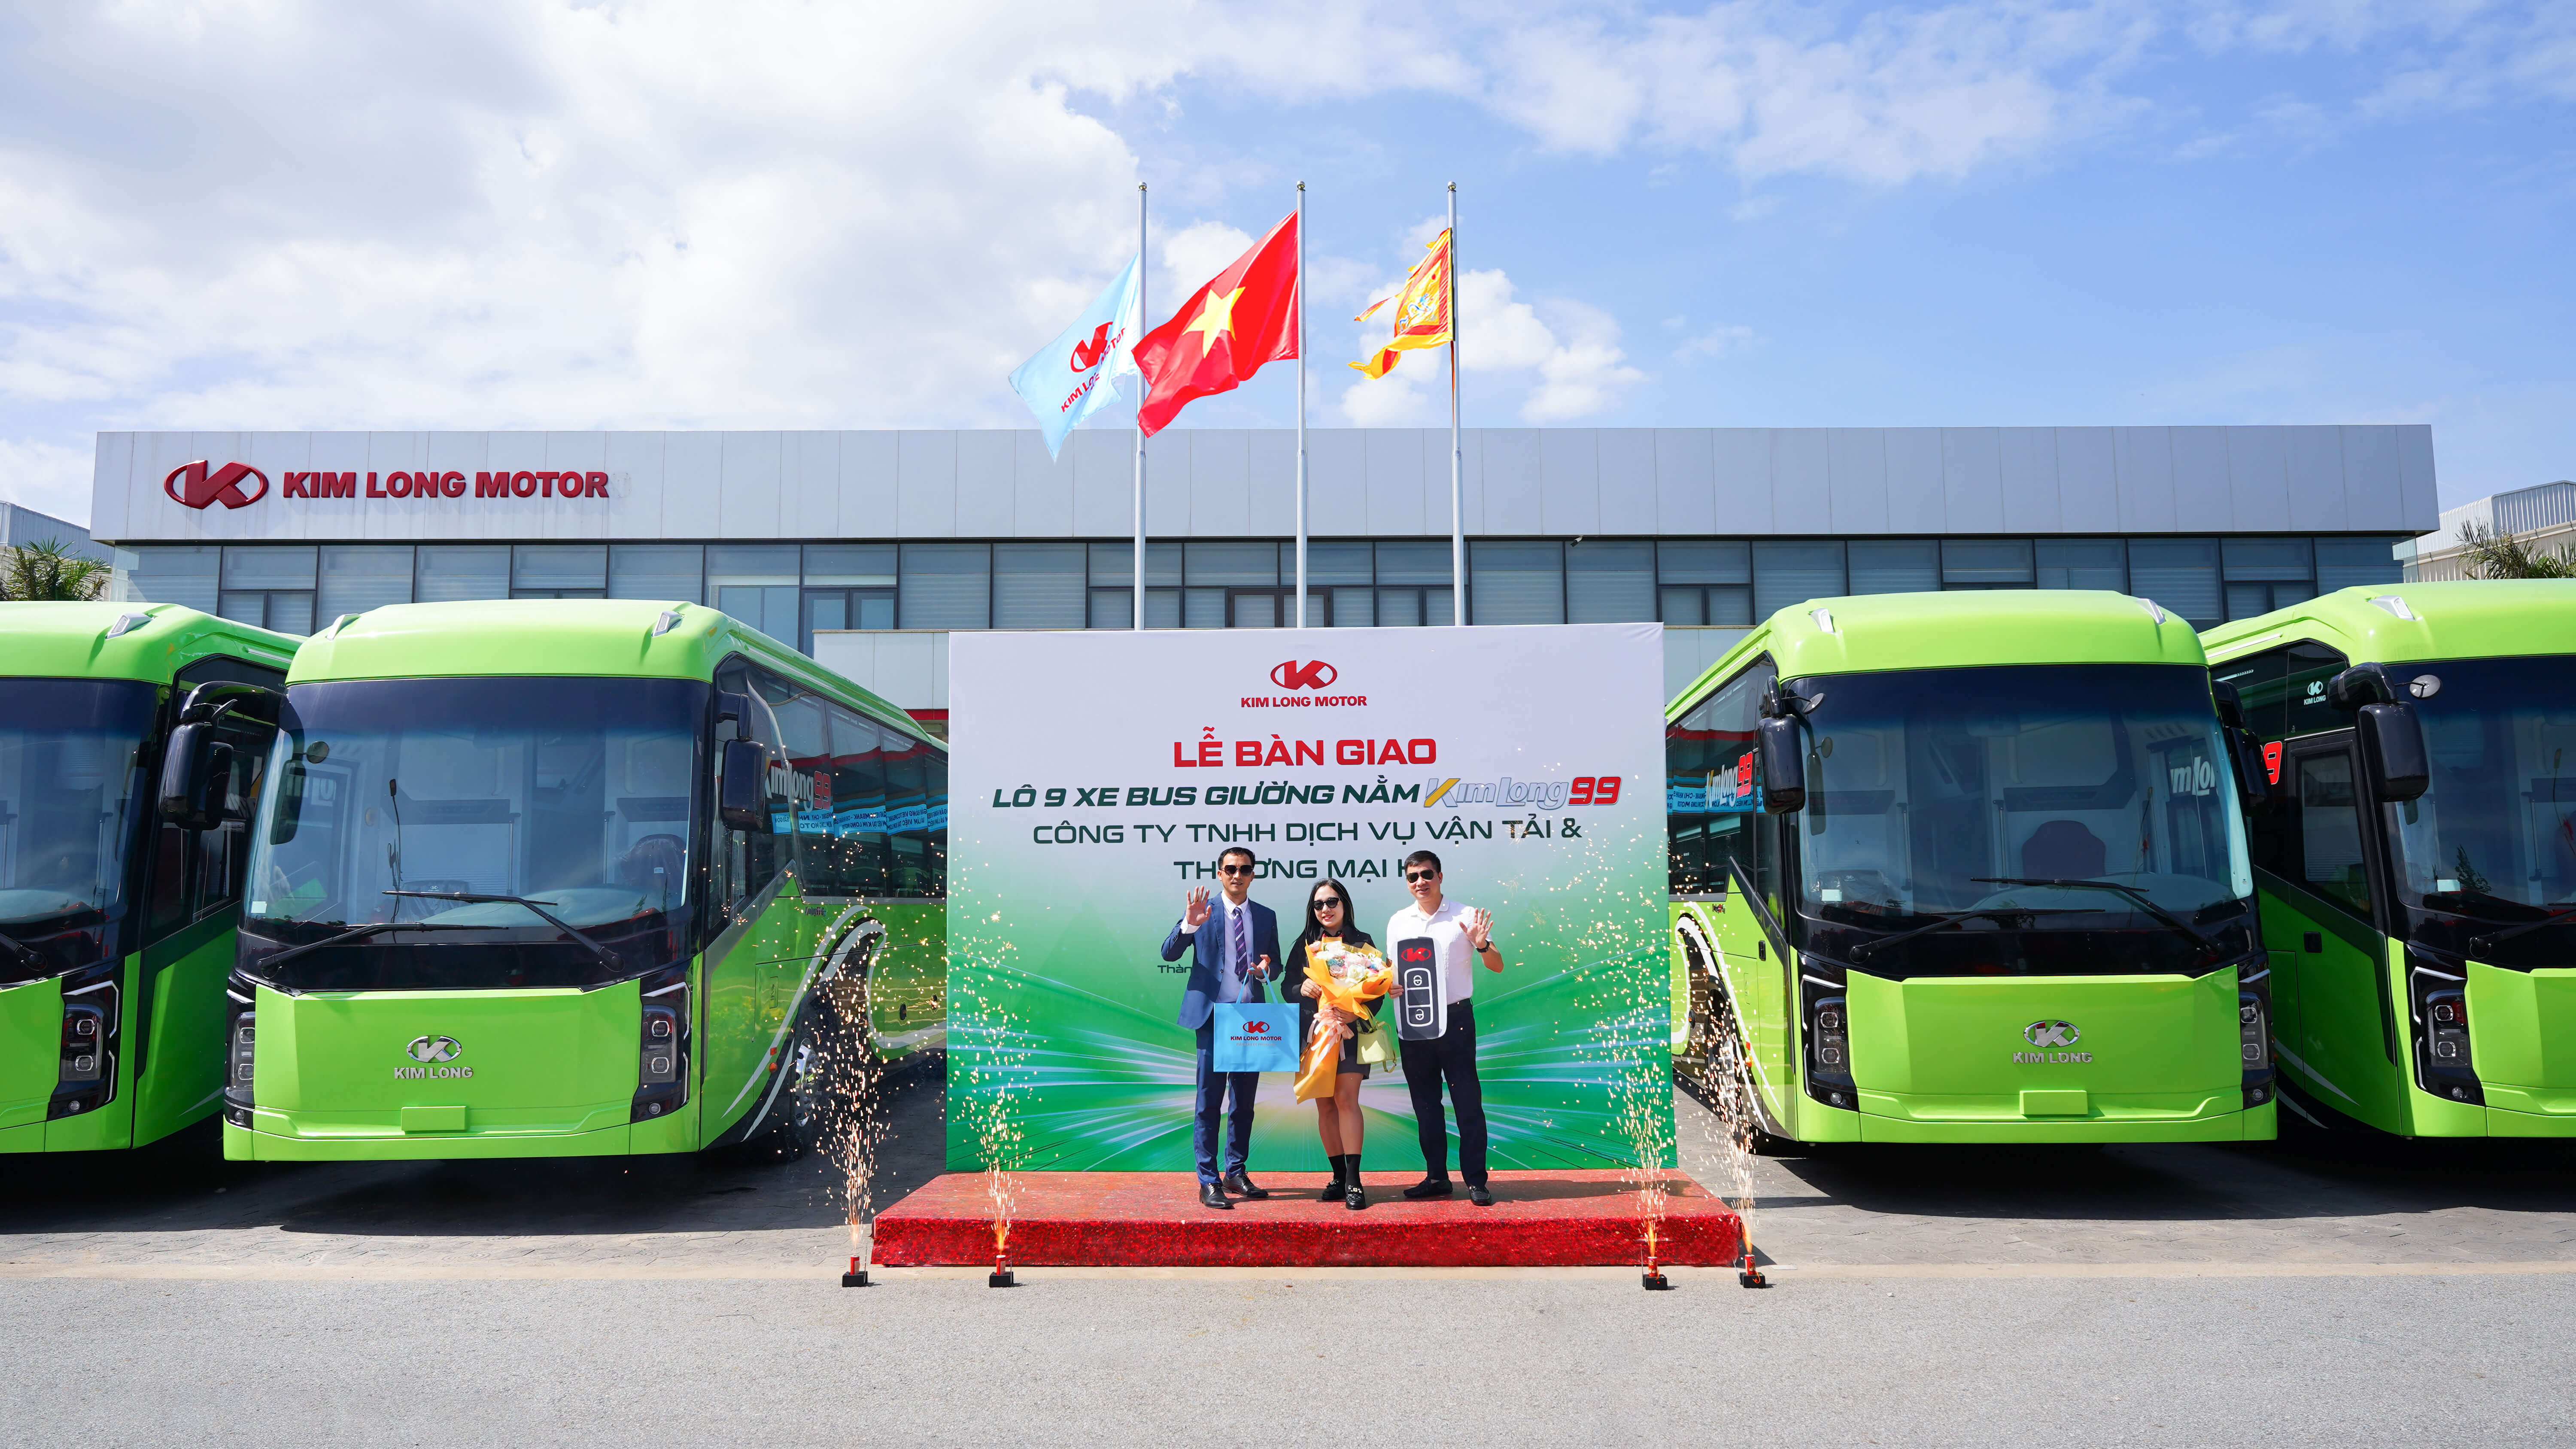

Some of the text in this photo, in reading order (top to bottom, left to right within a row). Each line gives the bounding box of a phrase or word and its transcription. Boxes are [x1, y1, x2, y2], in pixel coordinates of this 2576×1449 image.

[1061, 385, 1083, 412] KIM
[283, 471, 608, 497] KIM LONG MOTOR
[1241, 696, 1367, 707] KIM LONG MOTOR
[2313, 695, 2326, 703] LONG
[1174, 727, 1437, 767] LỄ BÀN GIAO
[992, 784, 1036, 808] LÔ
[1044, 788, 1066, 807] 9
[1073, 788, 1120, 806] XE
[1126, 787, 1197, 806] BUS
[1205, 781, 1335, 805] GIƯỜNG
[1342, 775, 1420, 804] NẰM
[1033, 813, 1582, 846] CÔNG TY TNHH DỊCH VỤ VẬN TẢI &
[1173, 858, 1317, 879] THƠNG
[1328, 859, 1387, 882] MẠI
[1157, 964, 1192, 973] Thàn
[2013, 1052, 2093, 1064] KIM LONG
[394, 1067, 473, 1079] KIM LONG
